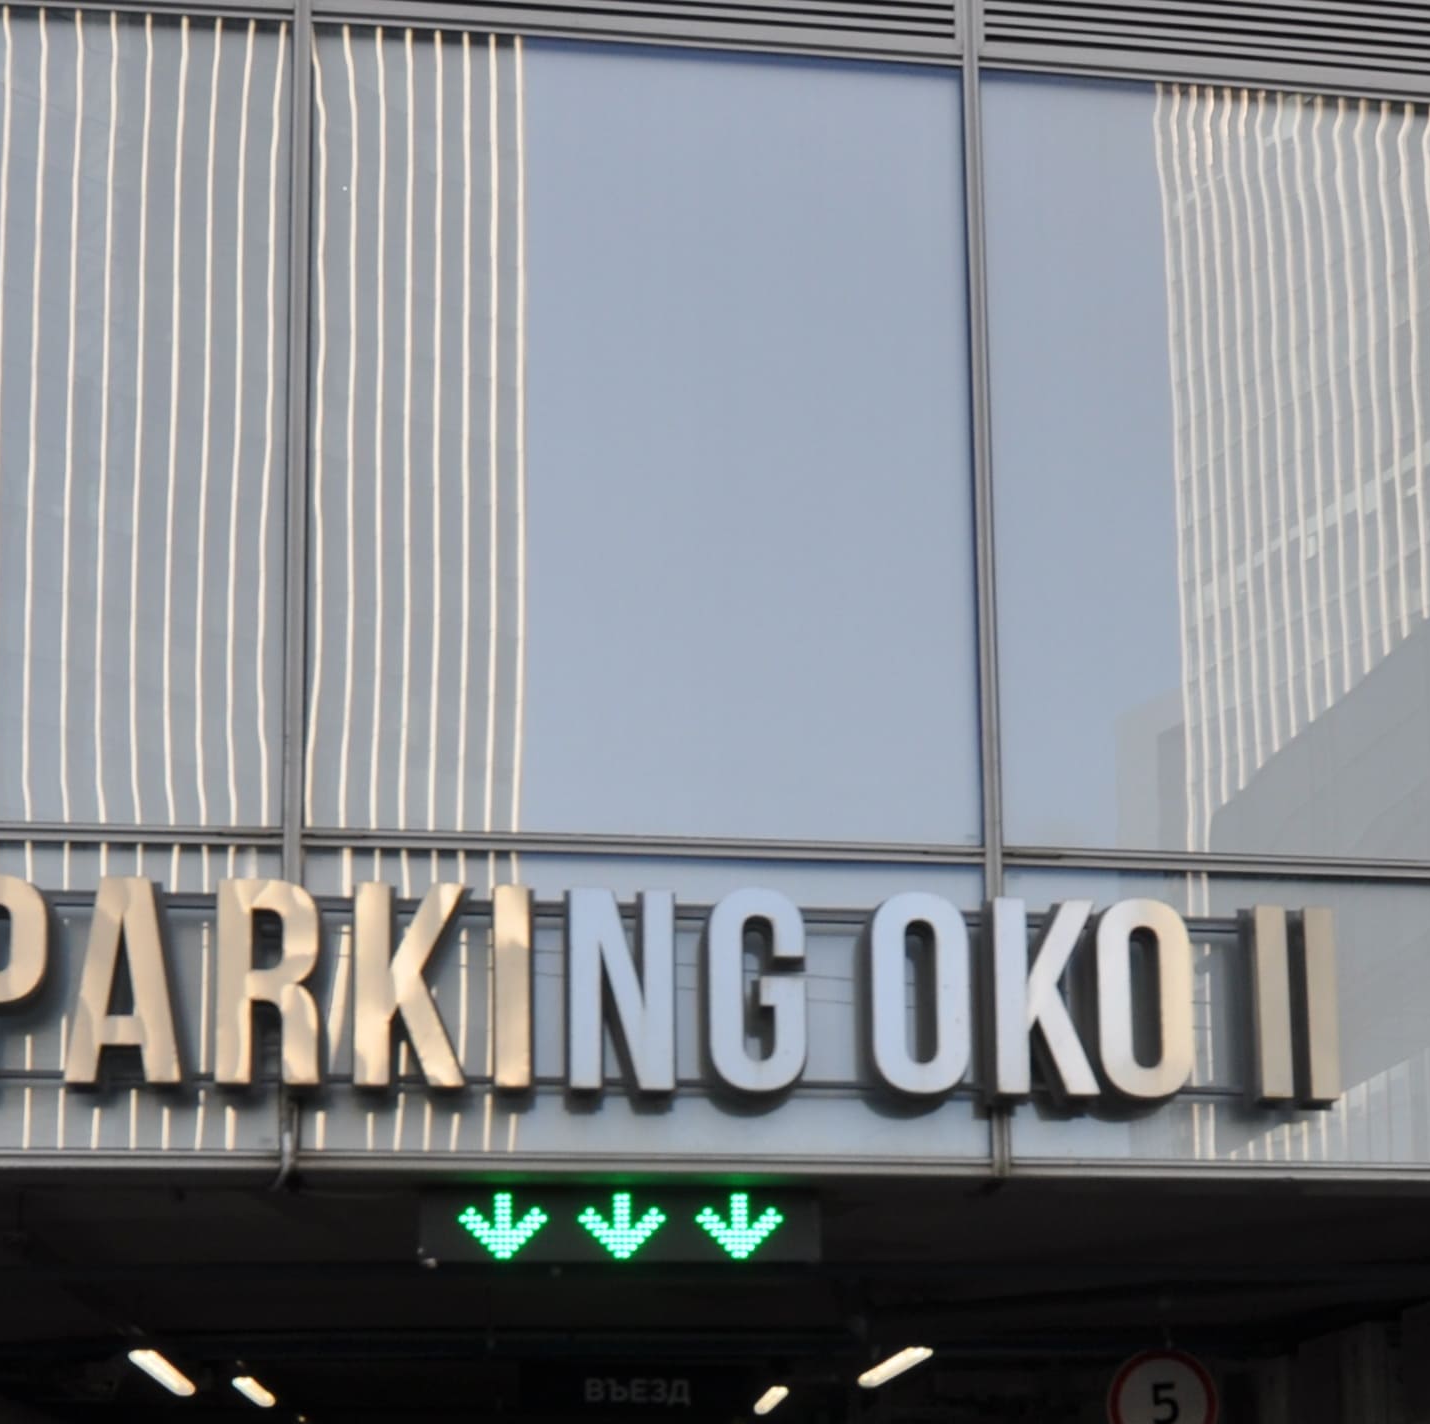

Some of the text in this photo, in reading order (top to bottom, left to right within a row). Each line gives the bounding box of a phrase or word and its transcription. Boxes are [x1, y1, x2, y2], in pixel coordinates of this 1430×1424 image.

[871, 890, 1195, 1101] OKO
[1251, 905, 1339, 1106] II
[584, 1377, 692, 1405] ВЪЕЗД
